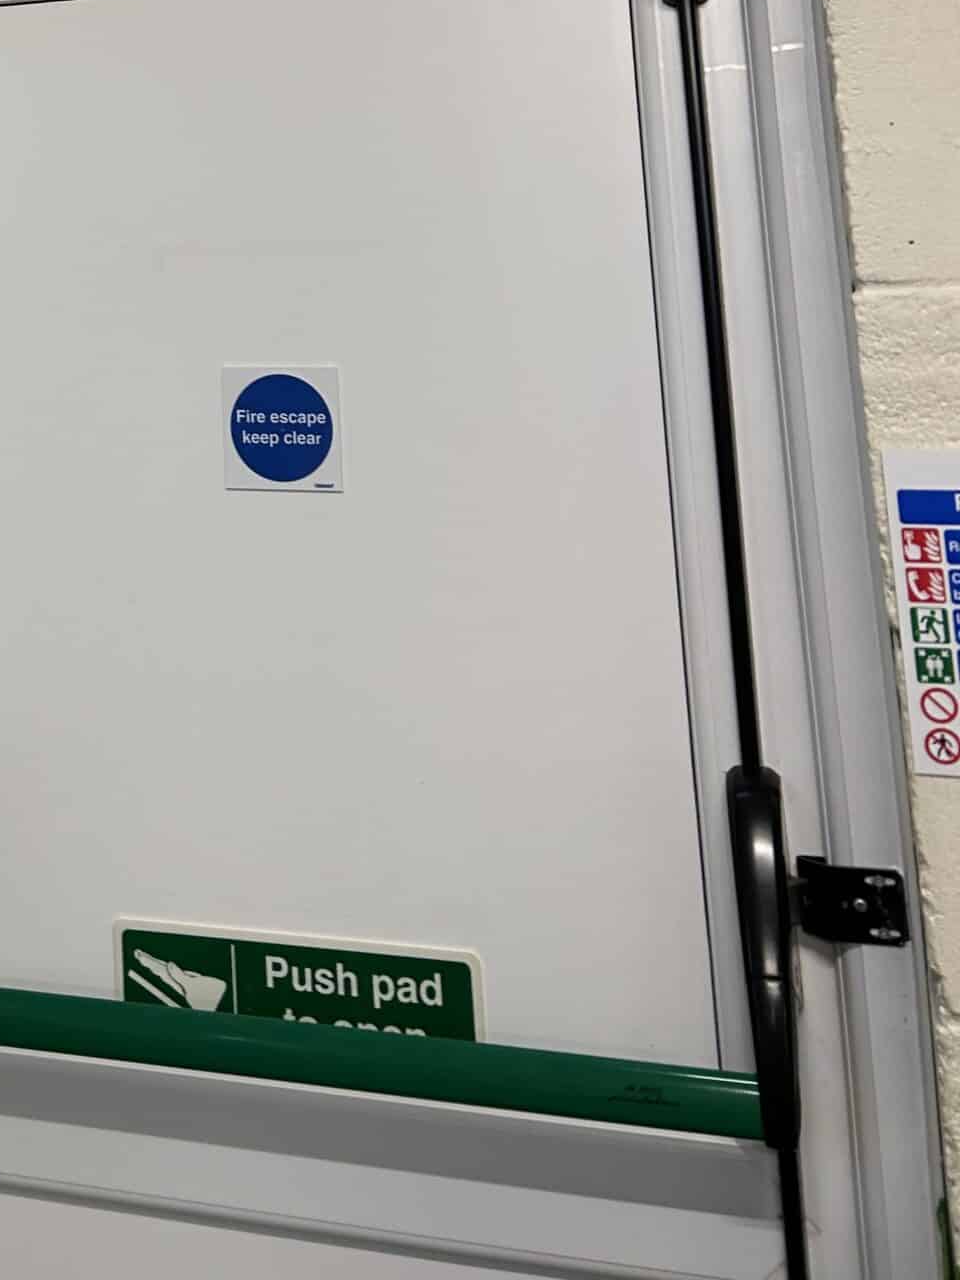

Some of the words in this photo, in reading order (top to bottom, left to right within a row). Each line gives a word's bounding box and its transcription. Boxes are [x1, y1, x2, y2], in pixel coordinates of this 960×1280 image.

[236, 409, 266, 423] Fire
[270, 411, 327, 427] escape
[242, 430, 279, 447] keep
[283, 430, 322, 445] clear
[264, 955, 359, 997] Push
[371, 973, 444, 1009] pad
